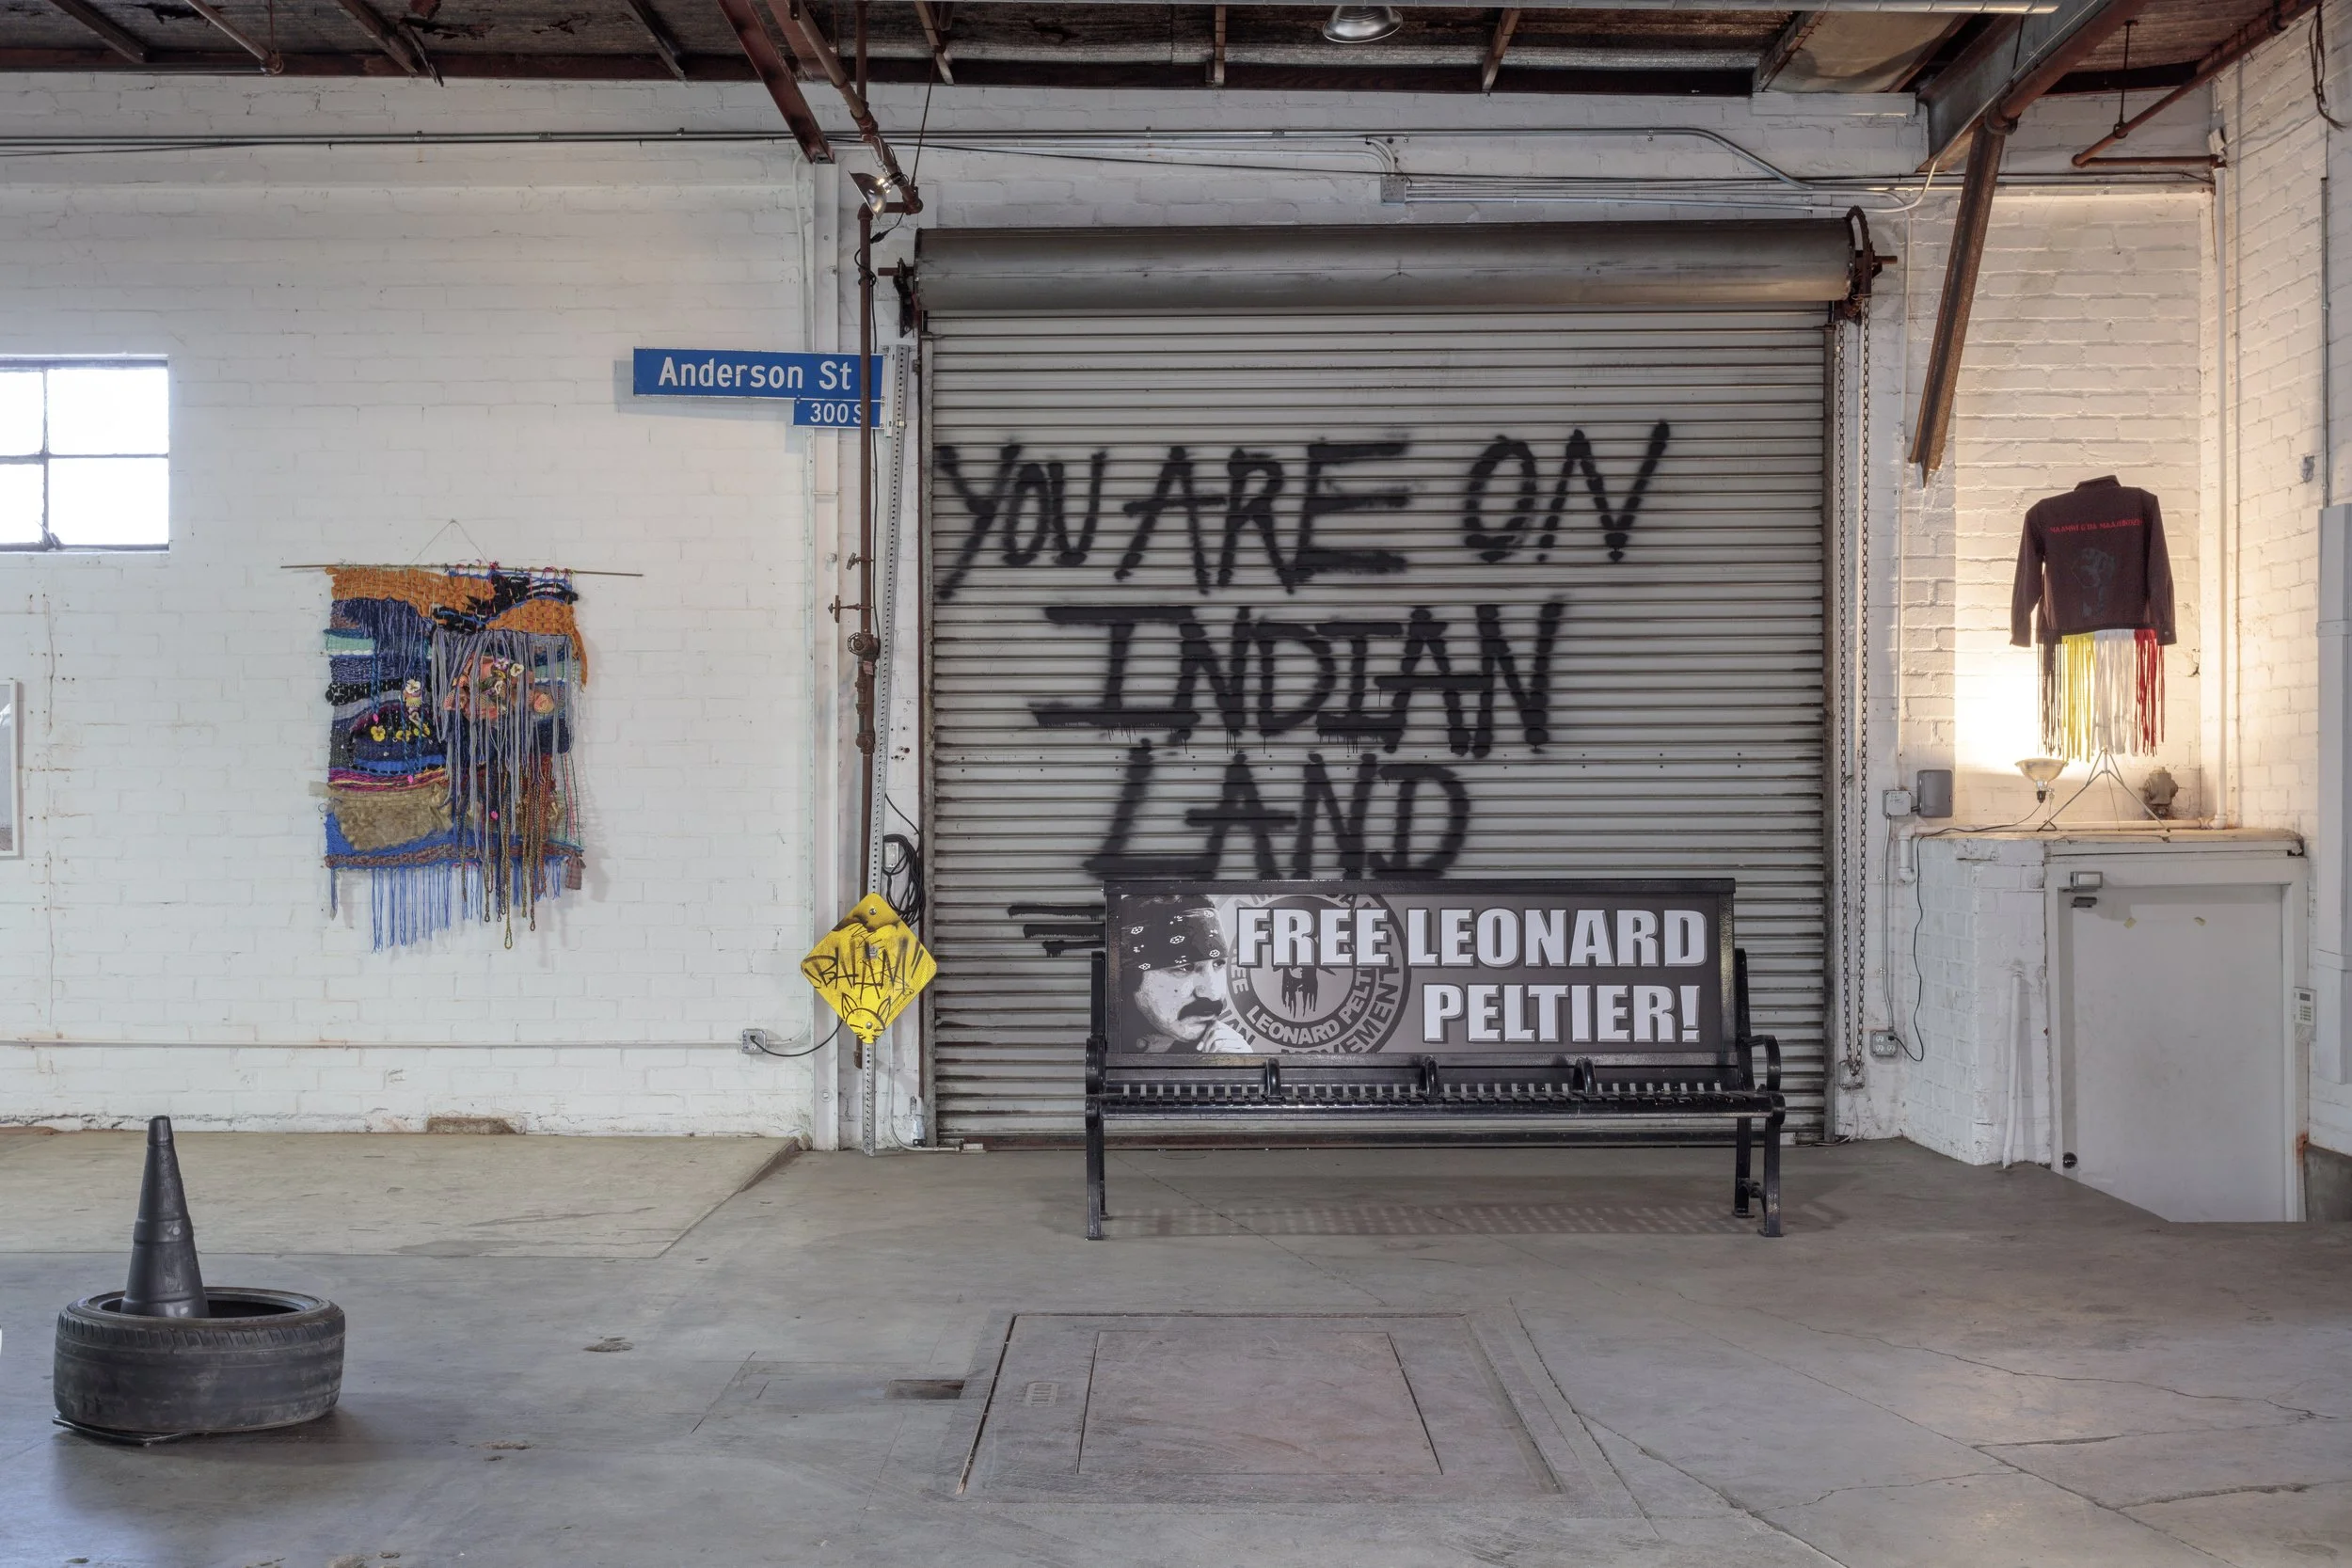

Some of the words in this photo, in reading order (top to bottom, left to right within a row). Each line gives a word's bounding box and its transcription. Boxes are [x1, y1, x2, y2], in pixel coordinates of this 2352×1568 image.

[658, 356, 803, 388] Anderson
[818, 360, 852, 390] St
[810, 403, 849, 423] 300
[935, 438, 1108, 600] YOU
[1114, 434, 1412, 595] ARE
[1463, 420, 1671, 565] ON
[1027, 594, 1567, 758] INDIAN
[1081, 738, 1471, 880] LAND
[1237, 908, 1390, 967] FREE
[1407, 909, 1708, 968] LEONARD
[1246, 1005, 1341, 1045] LEONARD
[1338, 967, 1373, 1025] PELT
[1422, 984, 1701, 1043] PELTIER!
